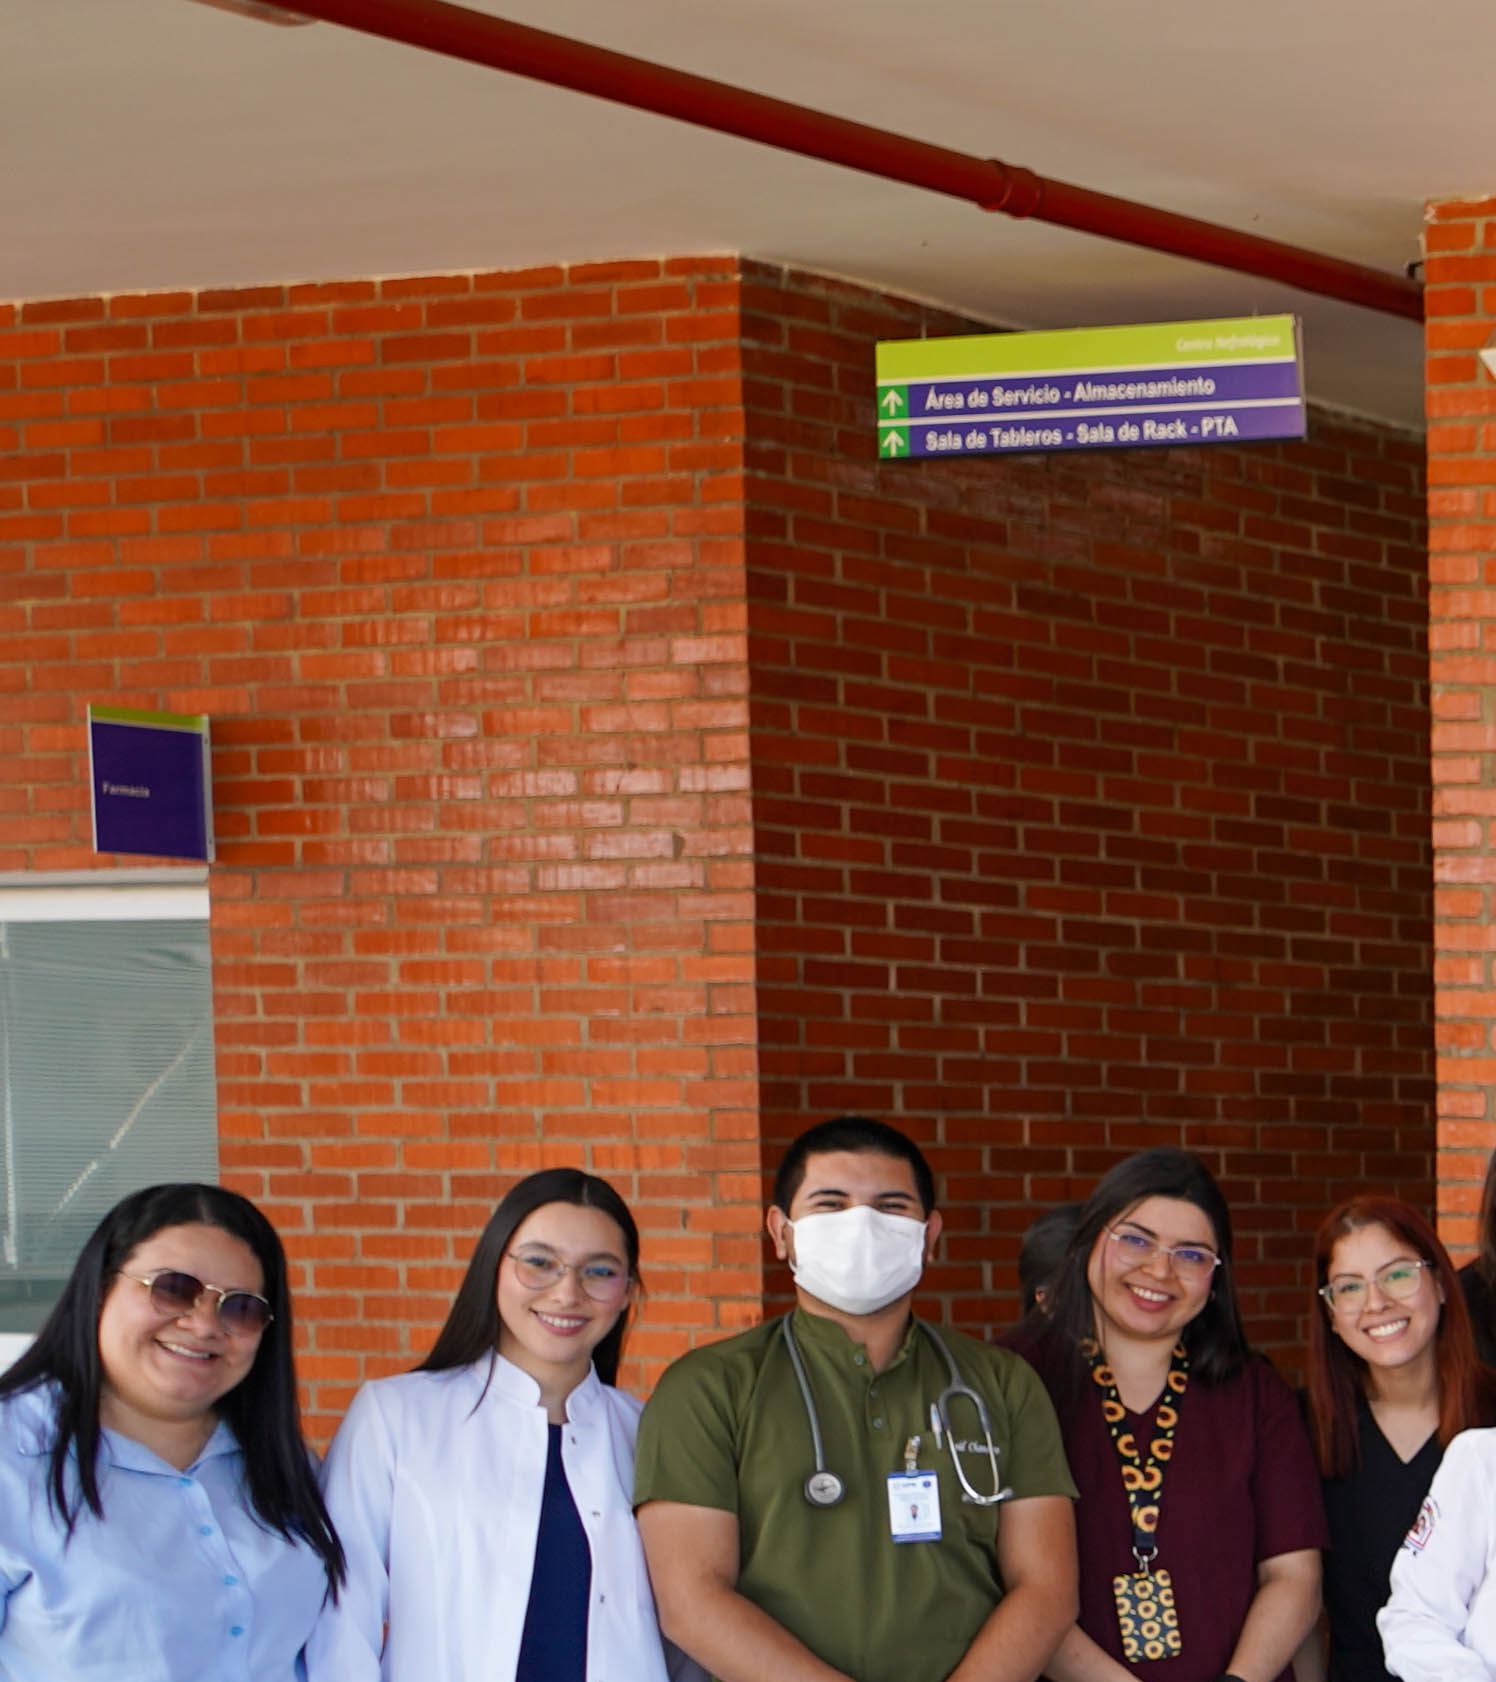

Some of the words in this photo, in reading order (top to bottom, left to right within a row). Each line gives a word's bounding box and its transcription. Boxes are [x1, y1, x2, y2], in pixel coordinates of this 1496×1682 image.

[924, 385, 964, 411] Área
[967, 388, 989, 408] de
[991, 384, 1060, 407] Servicio
[1073, 376, 1216, 402] Almacenamiento
[925, 430, 963, 452] Sala
[965, 429, 988, 450] de
[989, 426, 1063, 448] Tableros
[1076, 422, 1115, 444] Sala
[1117, 421, 1140, 442] de
[1142, 418, 1188, 440] Rack
[1201, 415, 1239, 437] PTA
